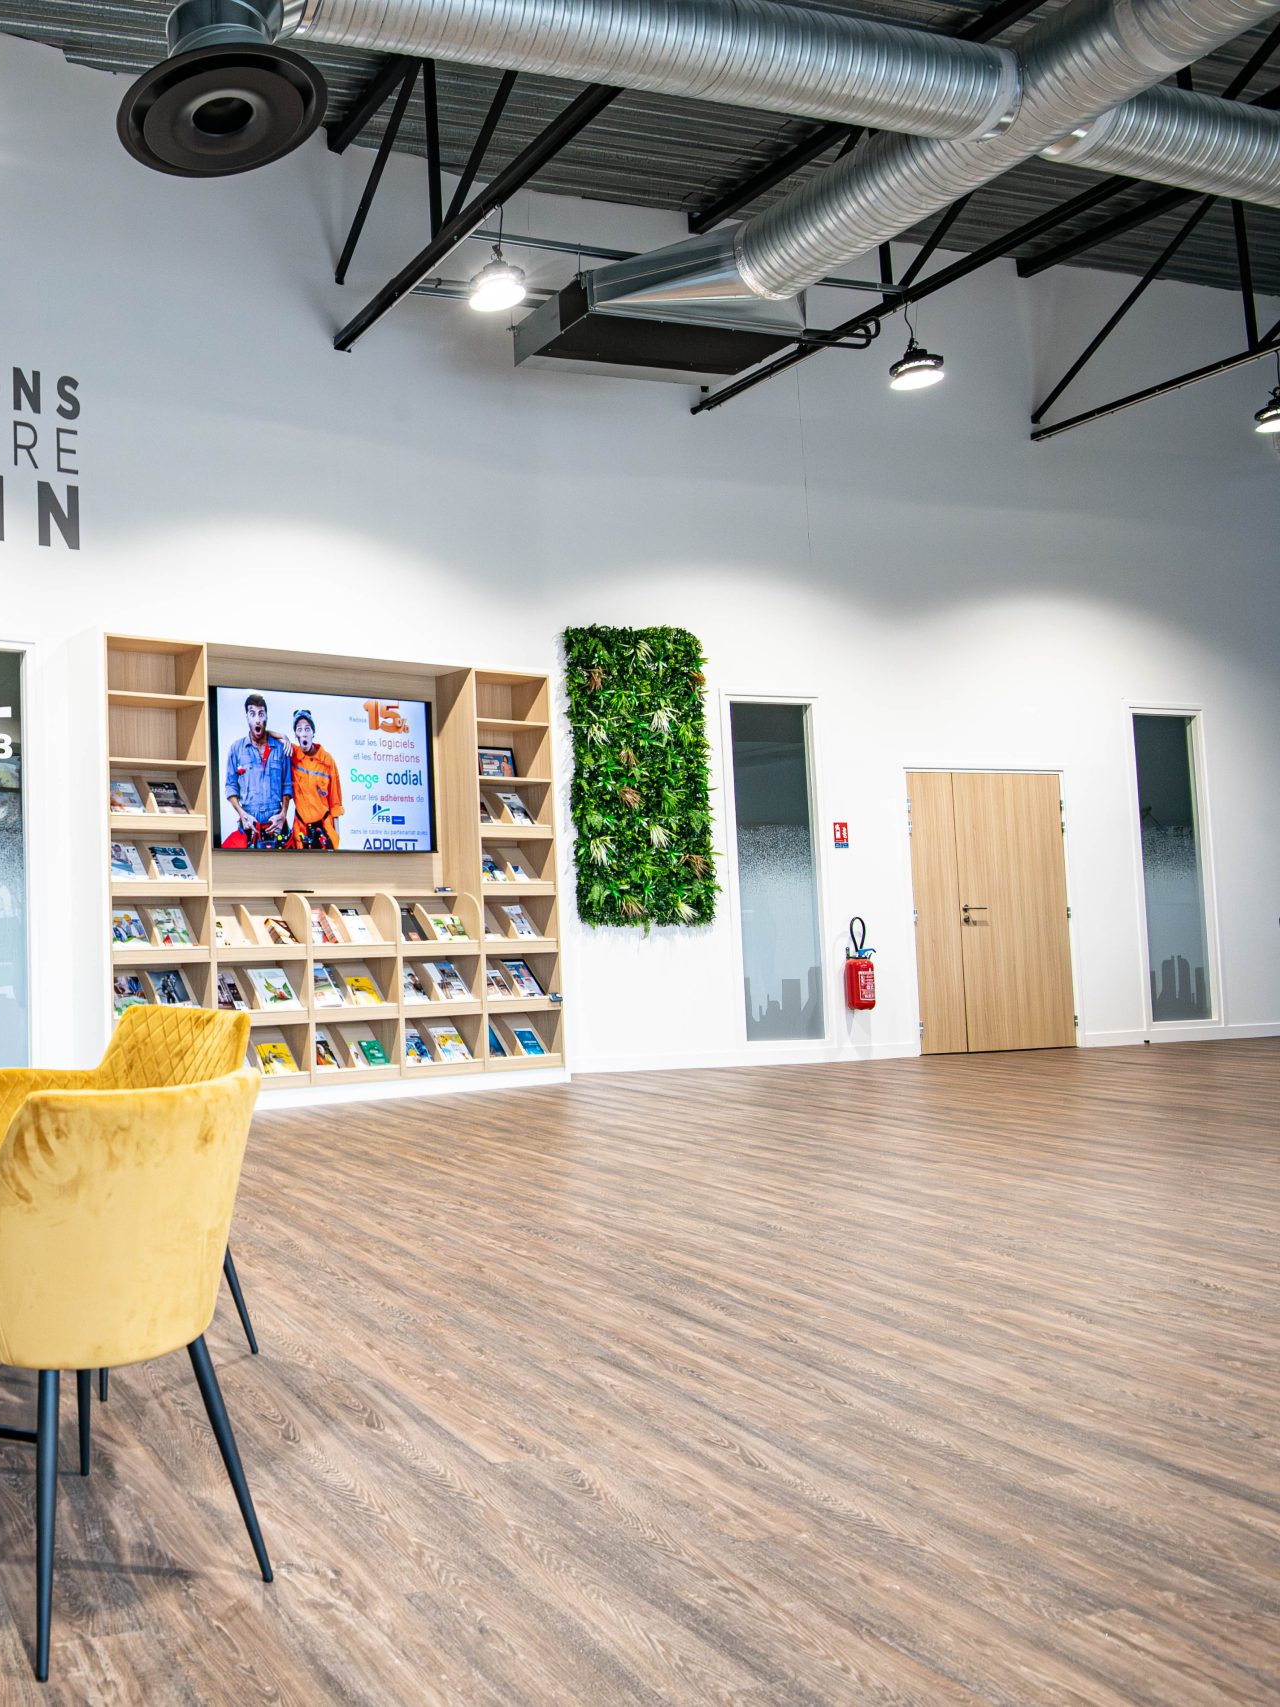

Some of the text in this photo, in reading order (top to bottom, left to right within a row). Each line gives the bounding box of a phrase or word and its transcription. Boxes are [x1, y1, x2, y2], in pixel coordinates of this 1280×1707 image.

[368, 738, 377, 747] les
[380, 738, 415, 750] logiciels
[353, 751, 421, 764] et les formations
[350, 768, 423, 789] Sage codial
[351, 793, 425, 803] pour les adhérents de
[377, 815, 391, 823] FFB
